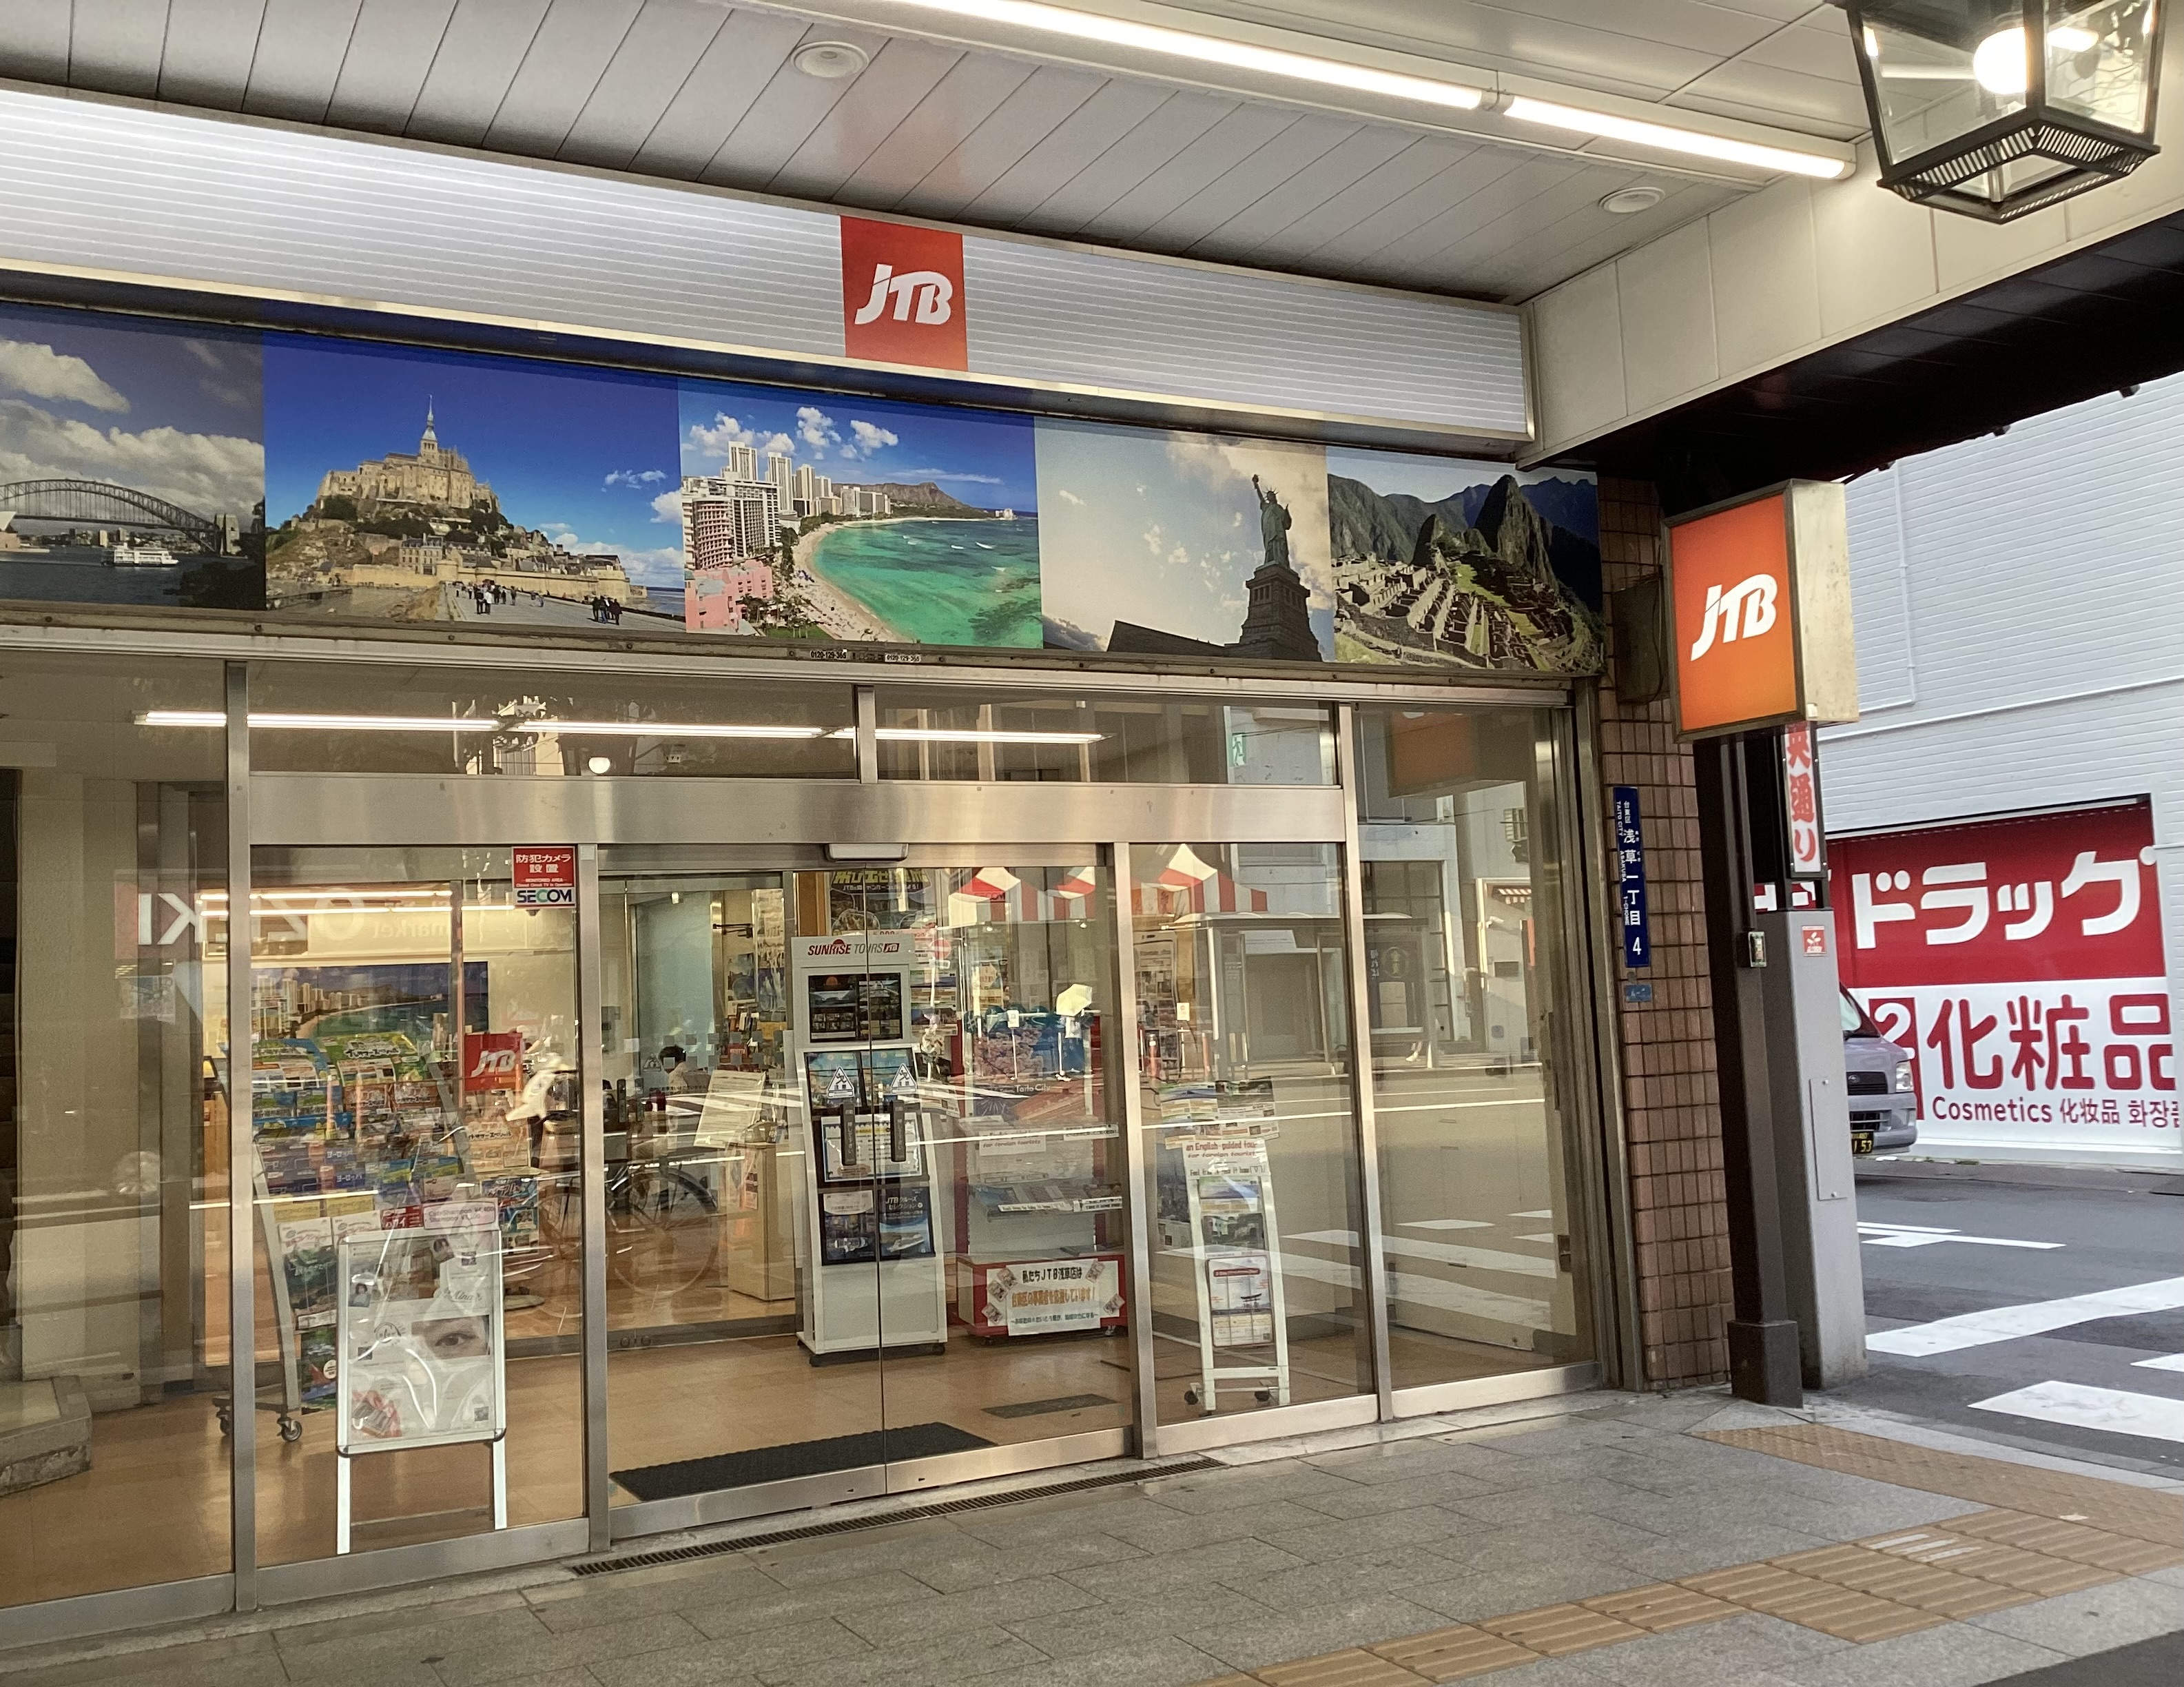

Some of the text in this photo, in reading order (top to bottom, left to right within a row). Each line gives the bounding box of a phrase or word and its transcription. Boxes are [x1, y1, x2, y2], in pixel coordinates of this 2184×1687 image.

[854, 263, 953, 325] JTB
[1690, 574, 1778, 662] JTB
[515, 854, 572, 863] 防犯カメラ
[529, 863, 559, 873] 設置
[517, 889, 572, 903] SECOM
[1852, 846, 2158, 950] ドラッグ
[807, 943, 852, 956] SUNRISE
[854, 943, 884, 954] TOURS
[1632, 937, 1642, 956] 4
[1927, 994, 2176, 1091] 化粧品
[471, 1050, 516, 1077] JTB
[1933, 1096, 2053, 1123] Cosmetics
[2059, 1098, 2121, 1125] 化妆品
